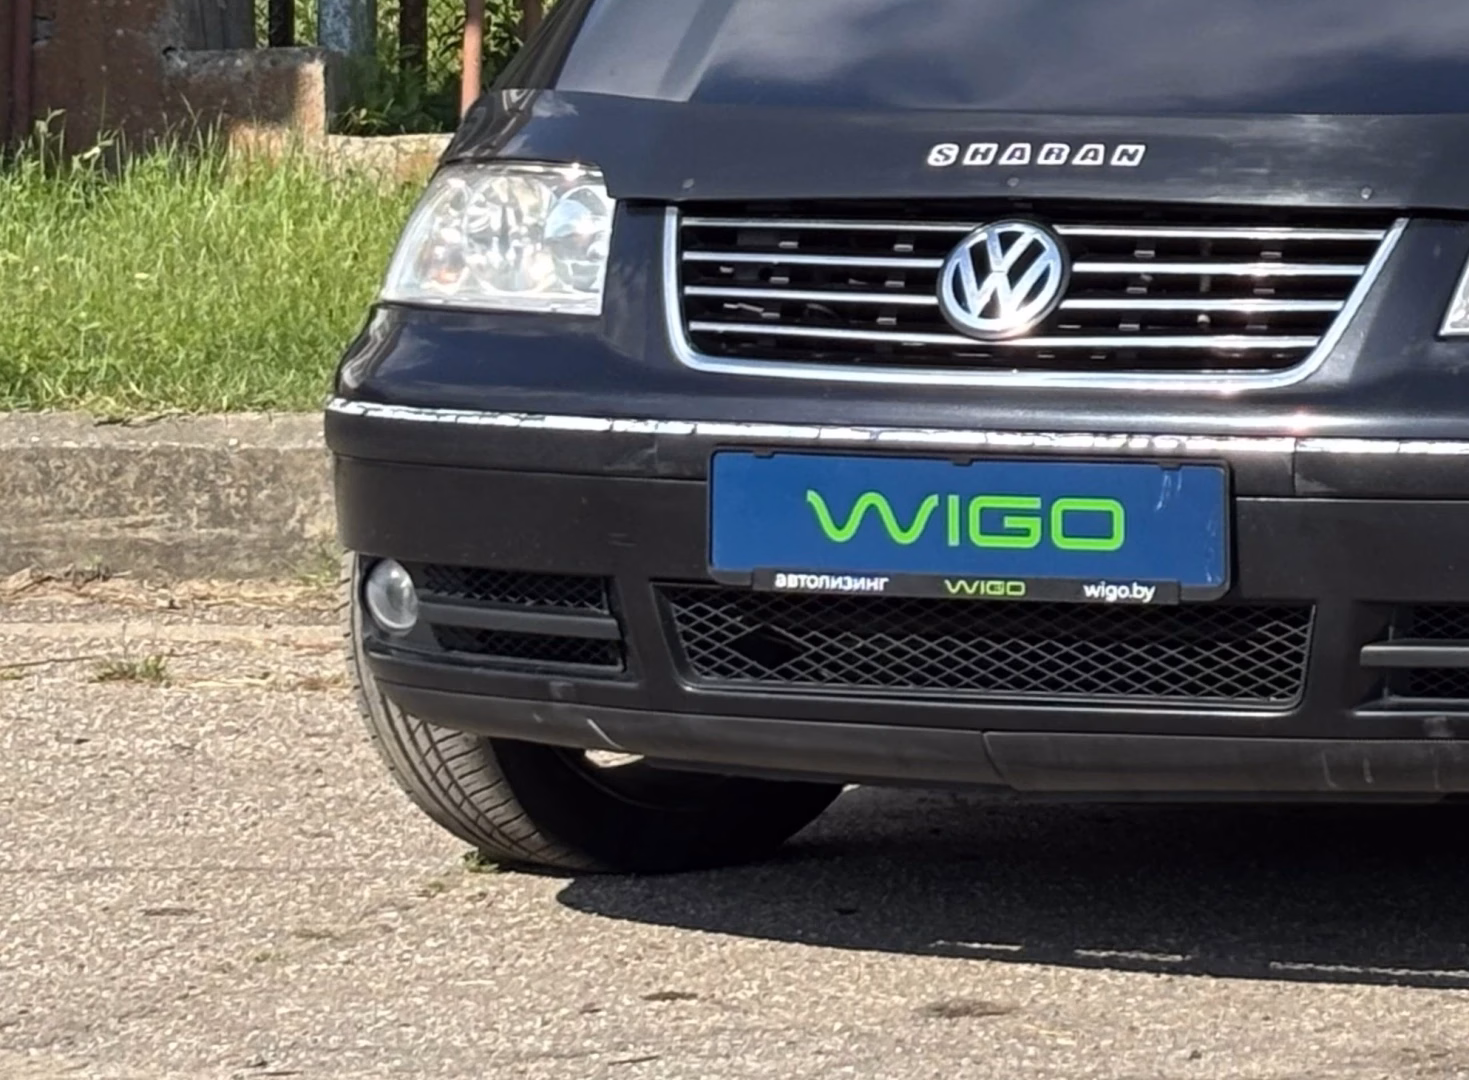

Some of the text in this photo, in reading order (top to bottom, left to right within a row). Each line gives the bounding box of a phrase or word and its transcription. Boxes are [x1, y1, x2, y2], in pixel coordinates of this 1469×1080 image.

[926, 142, 1146, 167] SHARAN
[940, 221, 1065, 333] VW
[806, 488, 1126, 552] WIGO
[774, 572, 890, 592] автолизинг
[944, 578, 1027, 597] WIGO
[1082, 580, 1156, 603] wigo.by
